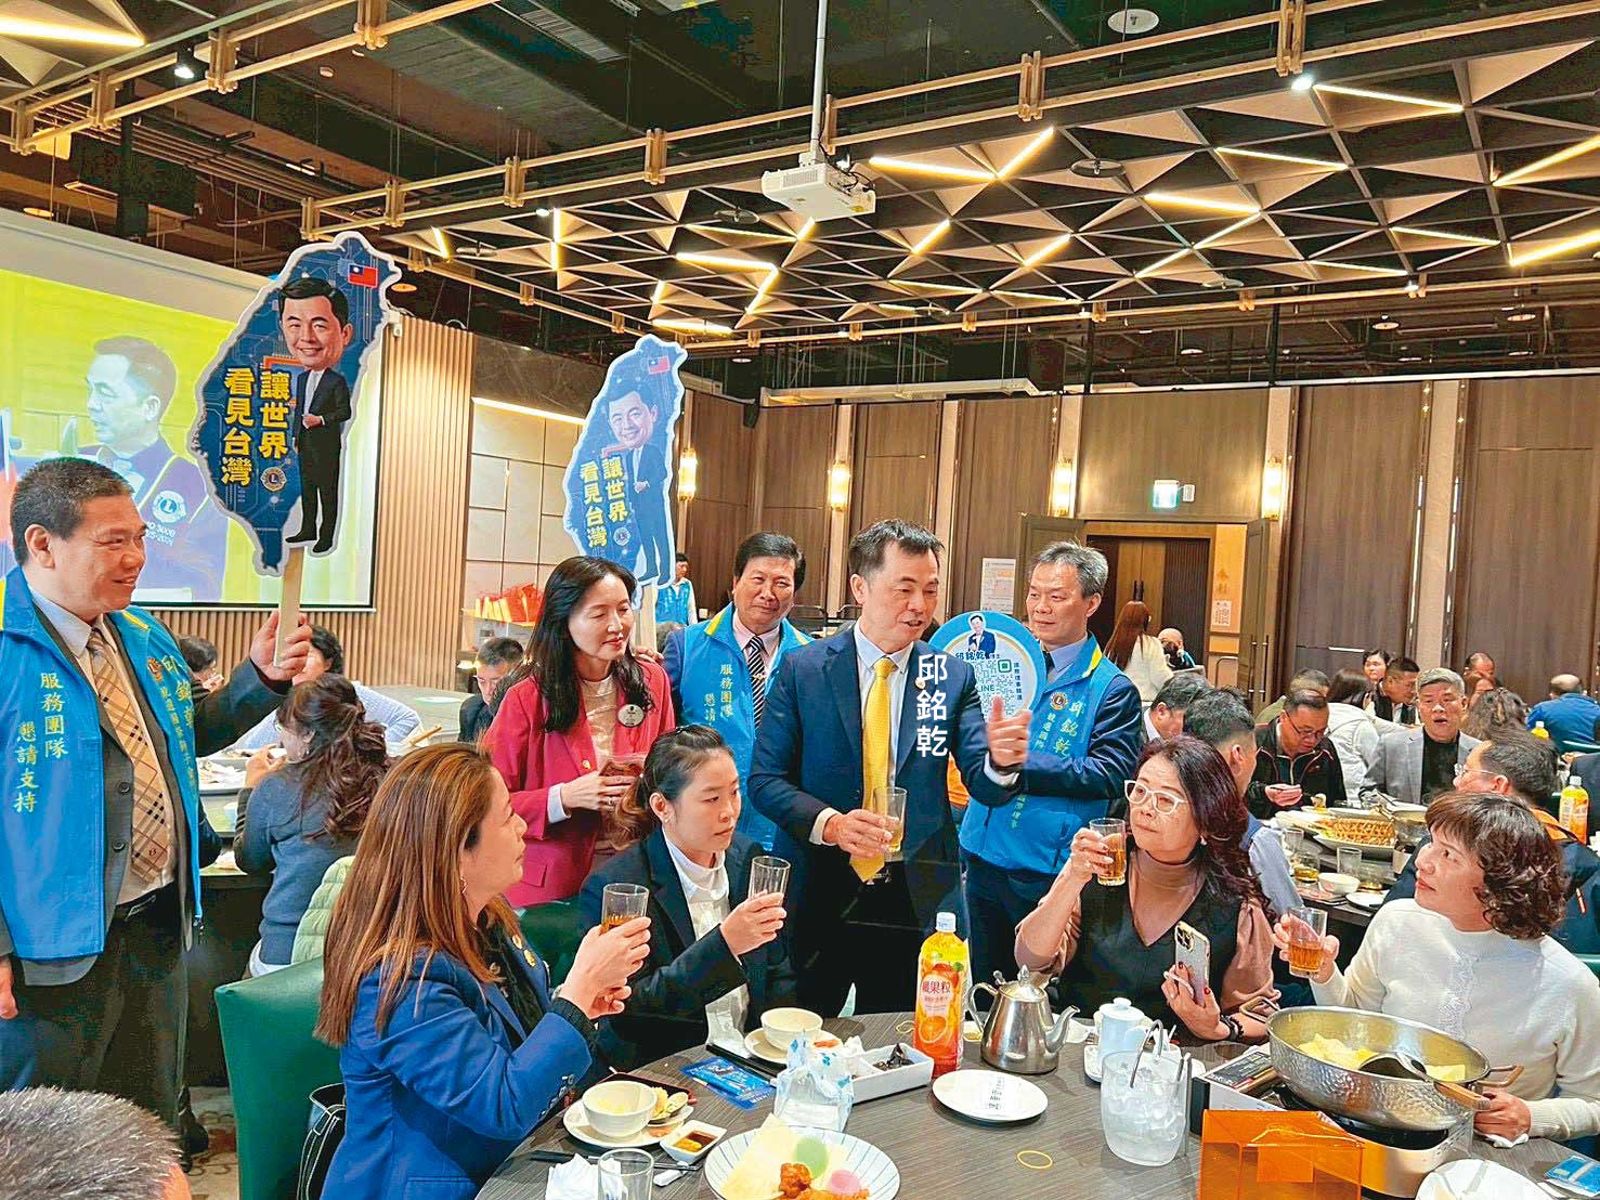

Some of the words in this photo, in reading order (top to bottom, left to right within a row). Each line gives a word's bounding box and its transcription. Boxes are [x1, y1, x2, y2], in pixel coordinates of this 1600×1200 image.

[221, 367, 255, 487] 看見台灣
[258, 370, 291, 459] 讓世界
[579, 459, 608, 548] 看見台灣
[603, 455, 630, 523] 讓世界
[40, 672, 69, 758] 服務團隊
[703, 693, 716, 725] 懇請
[719, 664, 734, 718] 服務團隊
[13, 721, 39, 813] 懇請支持
